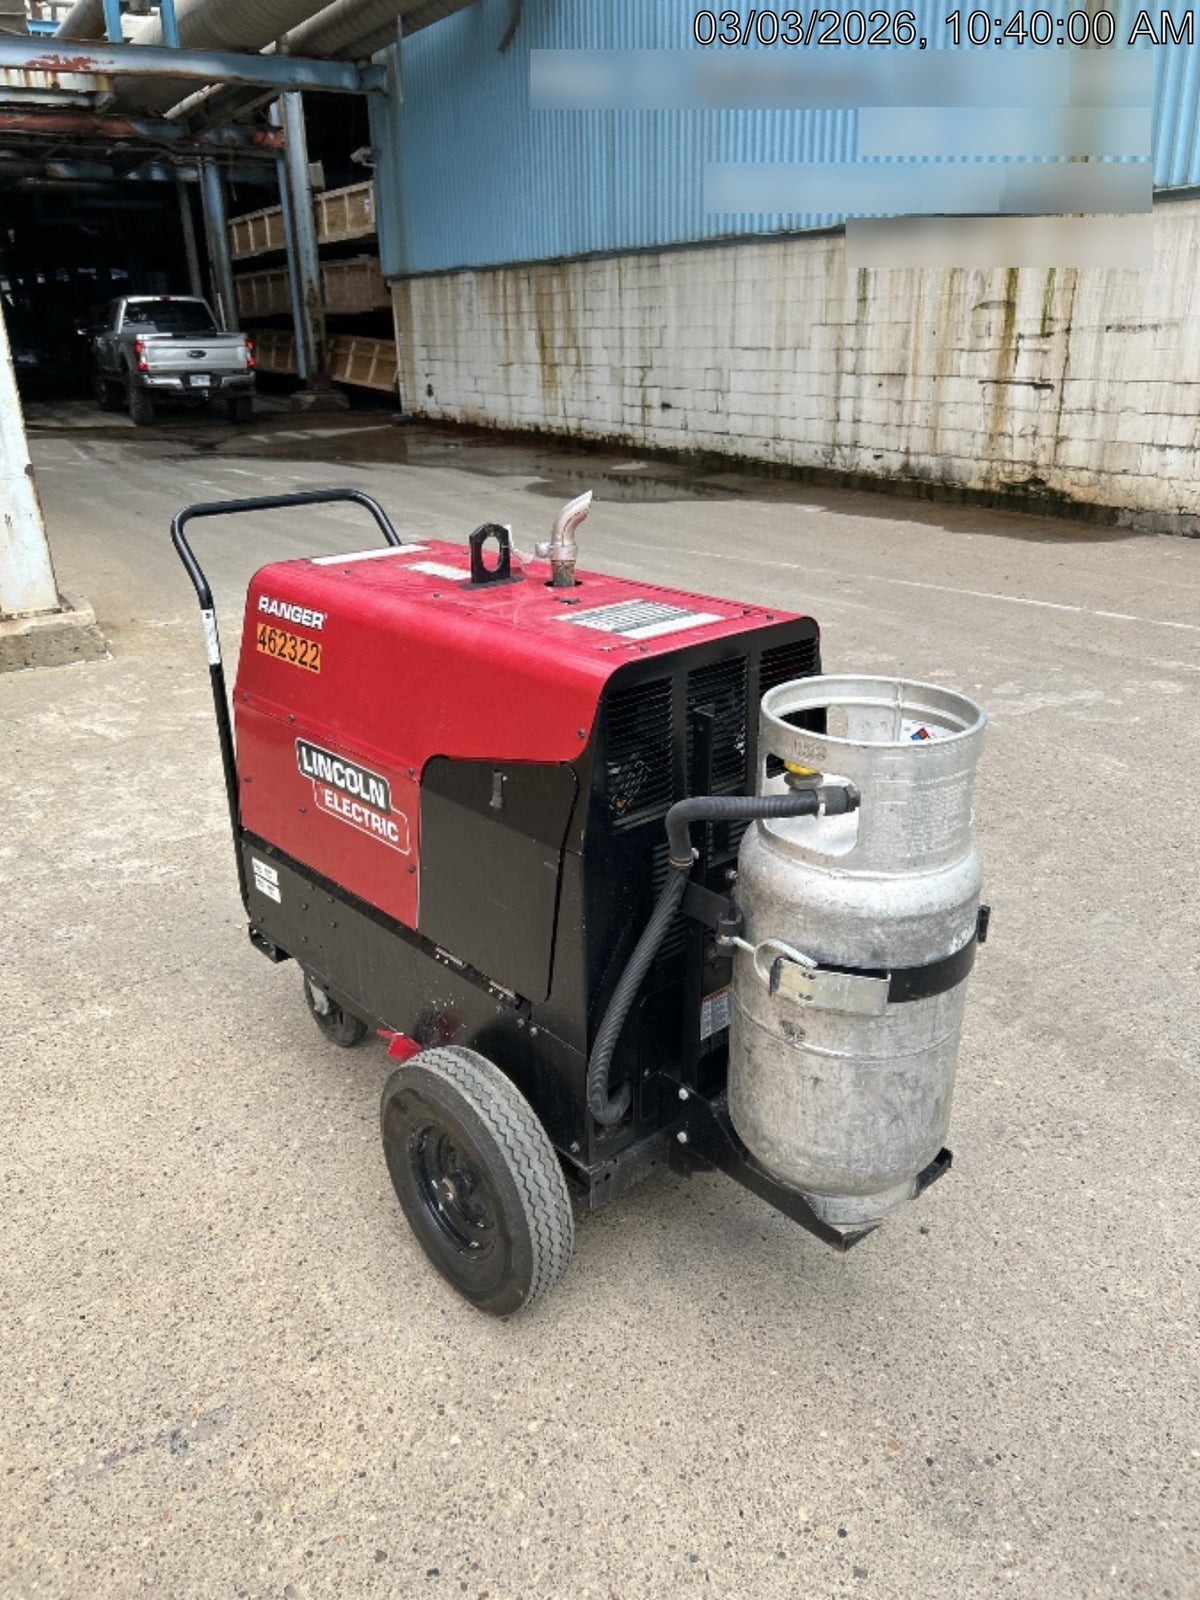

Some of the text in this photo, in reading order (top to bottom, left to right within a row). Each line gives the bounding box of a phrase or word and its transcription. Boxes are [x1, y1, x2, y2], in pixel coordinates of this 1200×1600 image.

[258, 595, 325, 630] RANGER
[258, 624, 320, 671] 462322
[301, 746, 387, 810] LINCOLN
[324, 788, 400, 843] ELECTRIC
